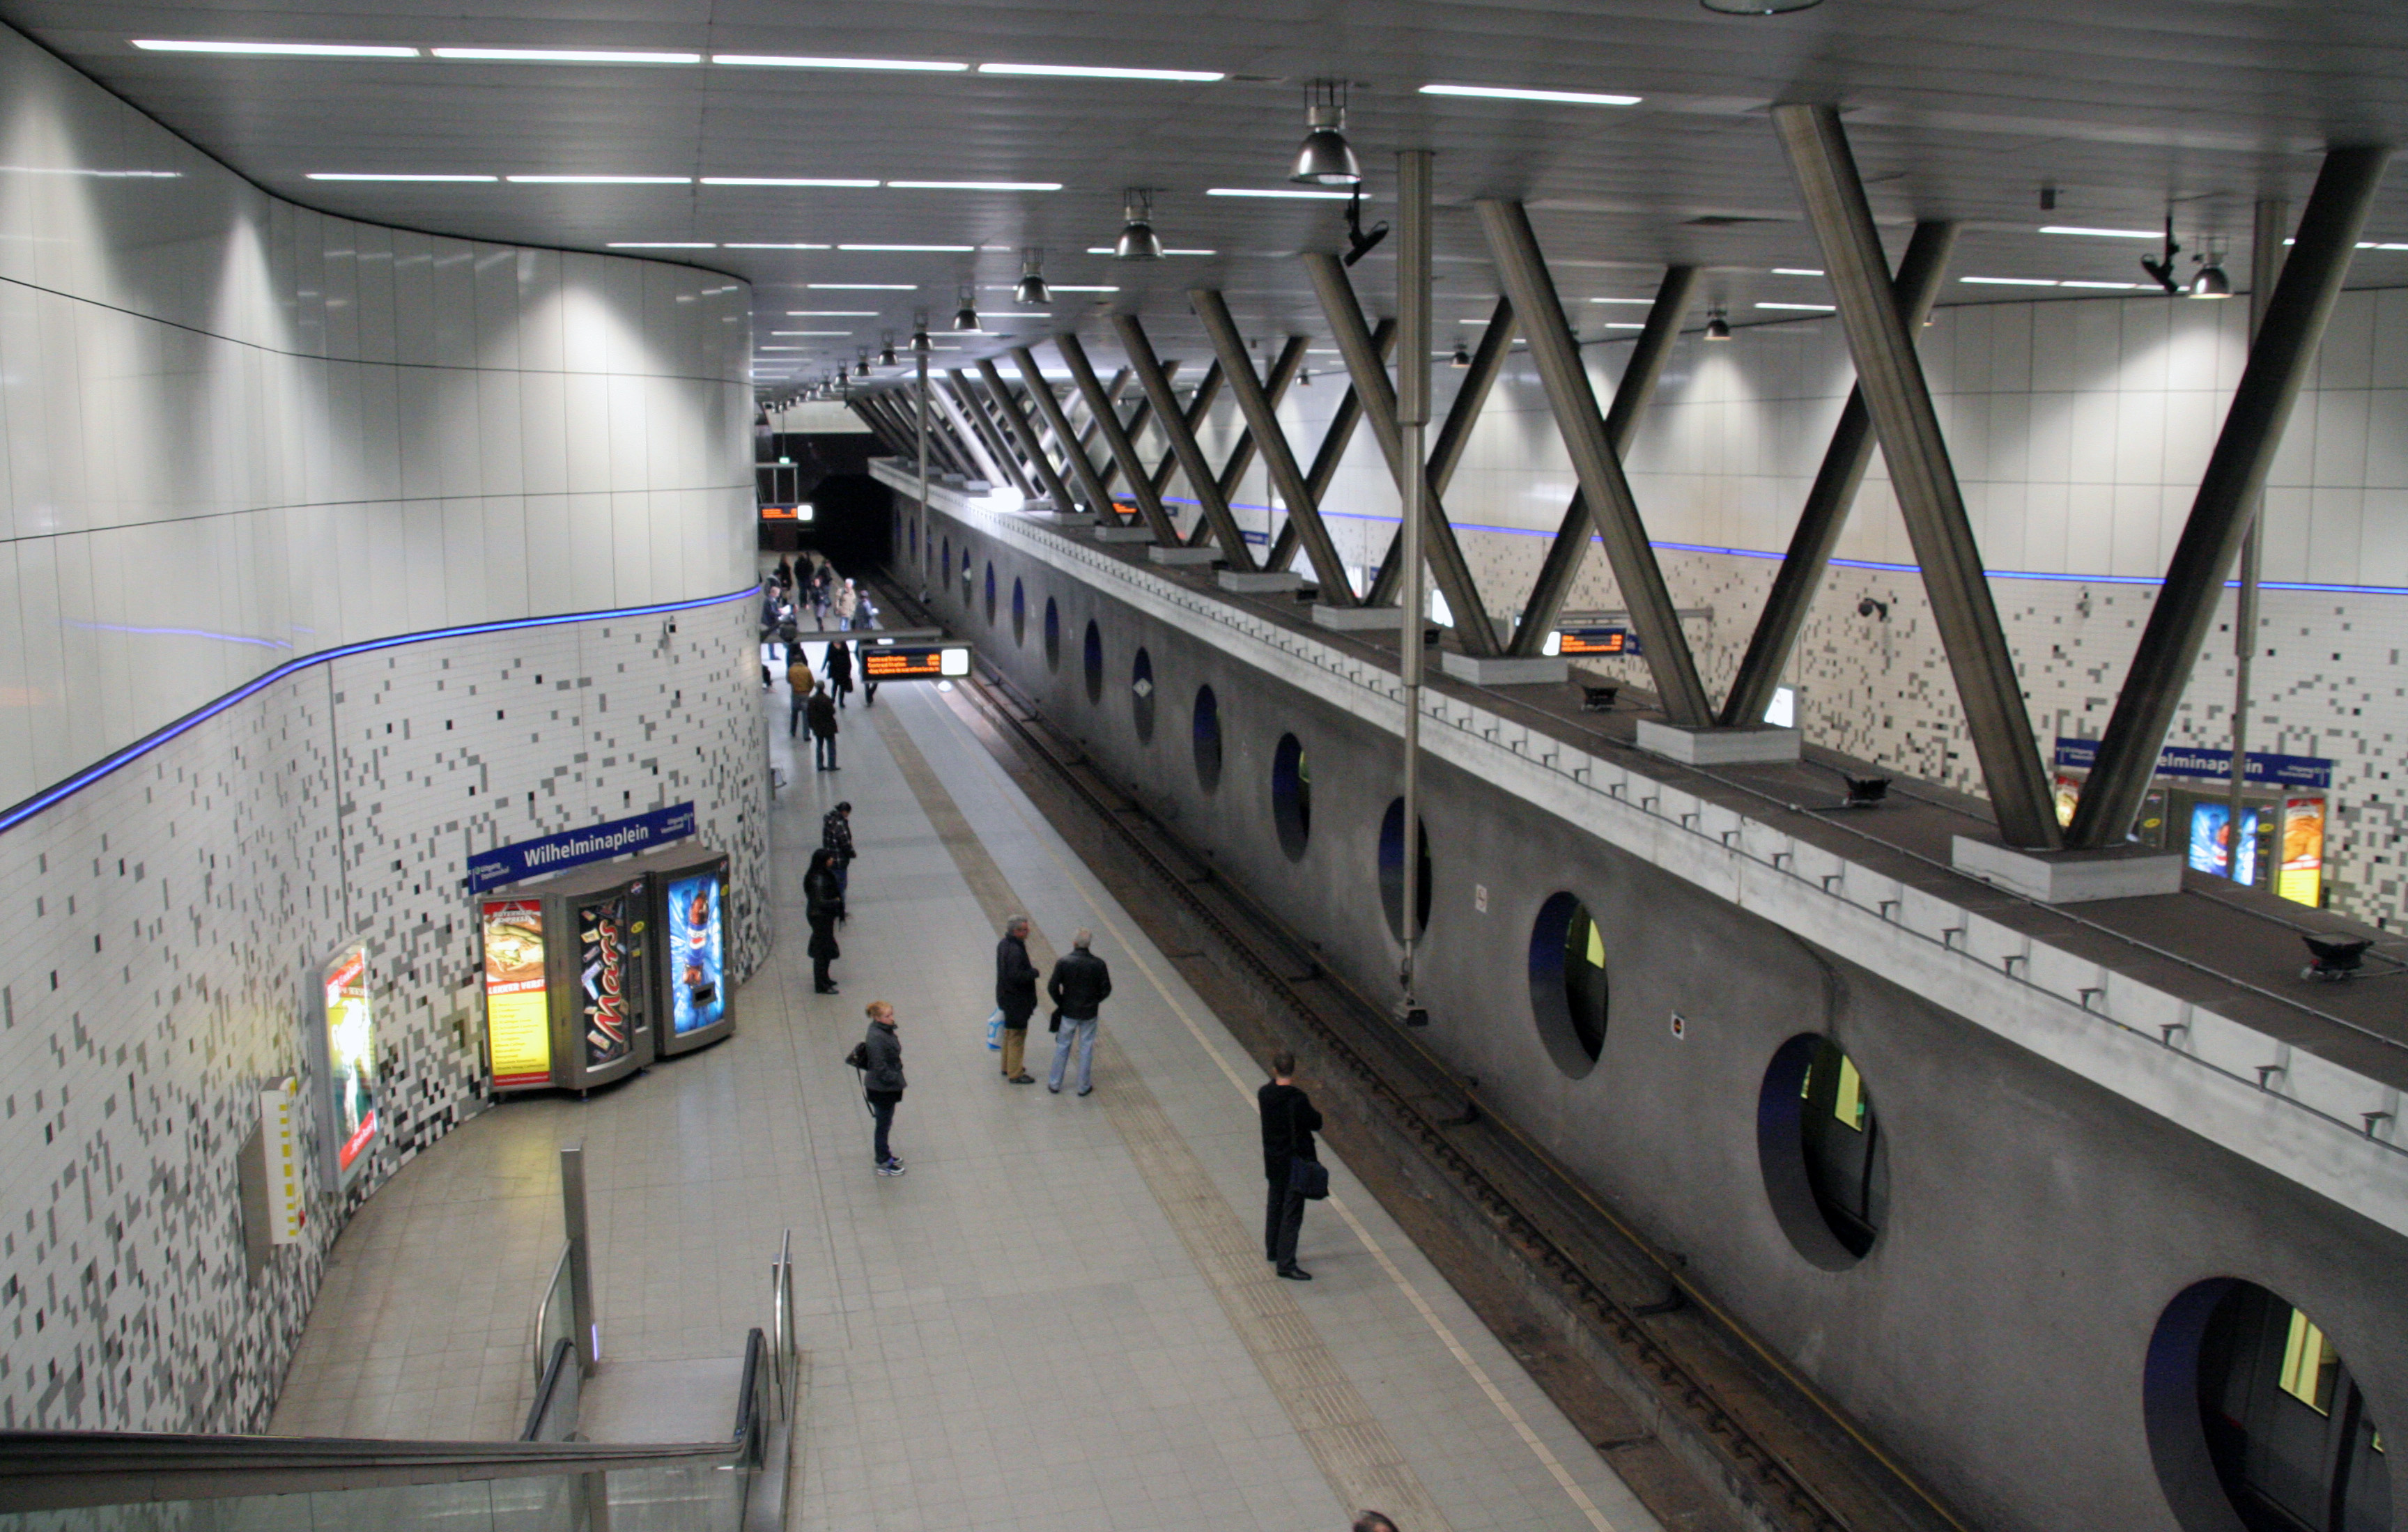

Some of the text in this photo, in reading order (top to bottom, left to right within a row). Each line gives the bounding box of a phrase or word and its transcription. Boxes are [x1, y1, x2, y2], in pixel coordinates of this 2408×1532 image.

[524, 824, 649, 867] Wilhelminaplein
[488, 982, 519, 994] LEKKER
[594, 919, 624, 1044] Mars
